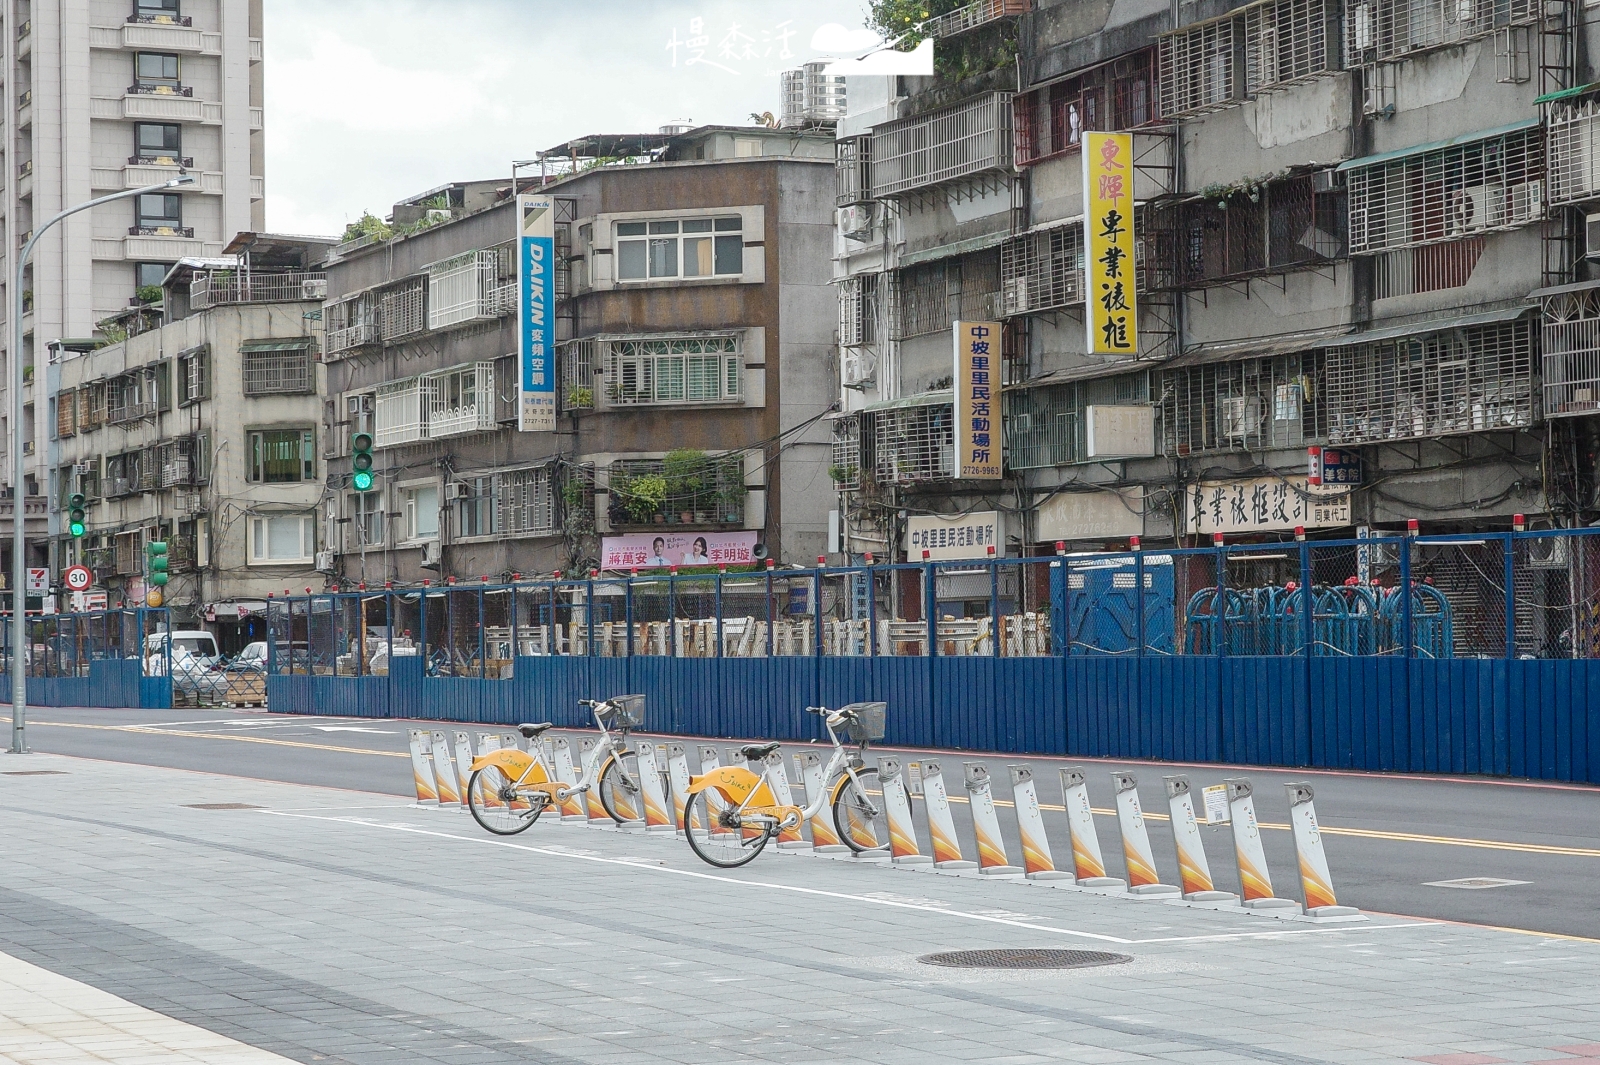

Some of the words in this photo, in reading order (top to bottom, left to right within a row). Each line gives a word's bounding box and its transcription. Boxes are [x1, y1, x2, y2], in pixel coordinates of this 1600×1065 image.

[530, 243, 544, 326] DAIKIN
[970, 325, 991, 464] 中坡里里民活動場所
[963, 466, 1000, 475] 2726-9963
[1324, 468, 1359, 482] 美容院
[1315, 507, 1348, 522] 同業代工
[912, 524, 994, 549] 中坡里里民活動場所
[608, 551, 648, 565] 蔣萬安
[710, 548, 750, 562] 李明璇
[70, 573, 86, 583] 30
